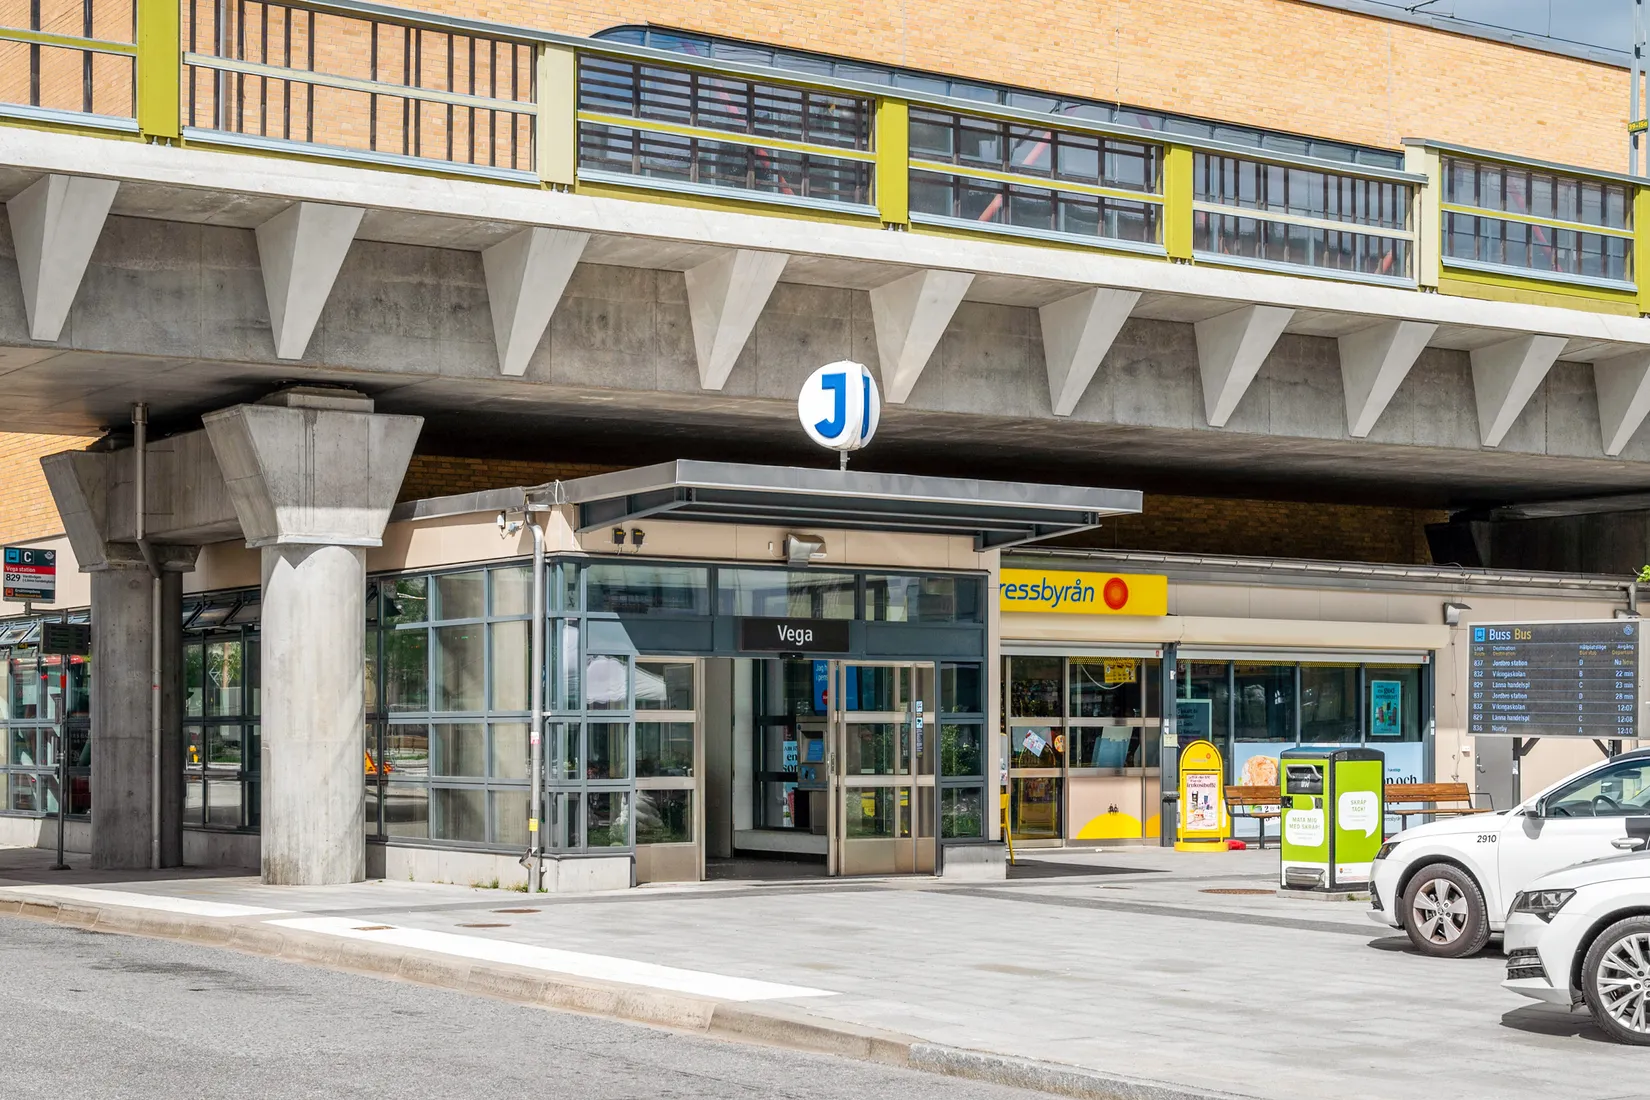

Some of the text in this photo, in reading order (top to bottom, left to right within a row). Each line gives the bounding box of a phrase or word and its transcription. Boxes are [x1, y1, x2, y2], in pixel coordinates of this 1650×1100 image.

[814, 372, 846, 438] J
[24, 552, 31, 562] C
[777, 625, 813, 646] Vega
[1489, 628, 1531, 640] Buss Bus
[1492, 671, 1526, 679] Vikingaskolan
